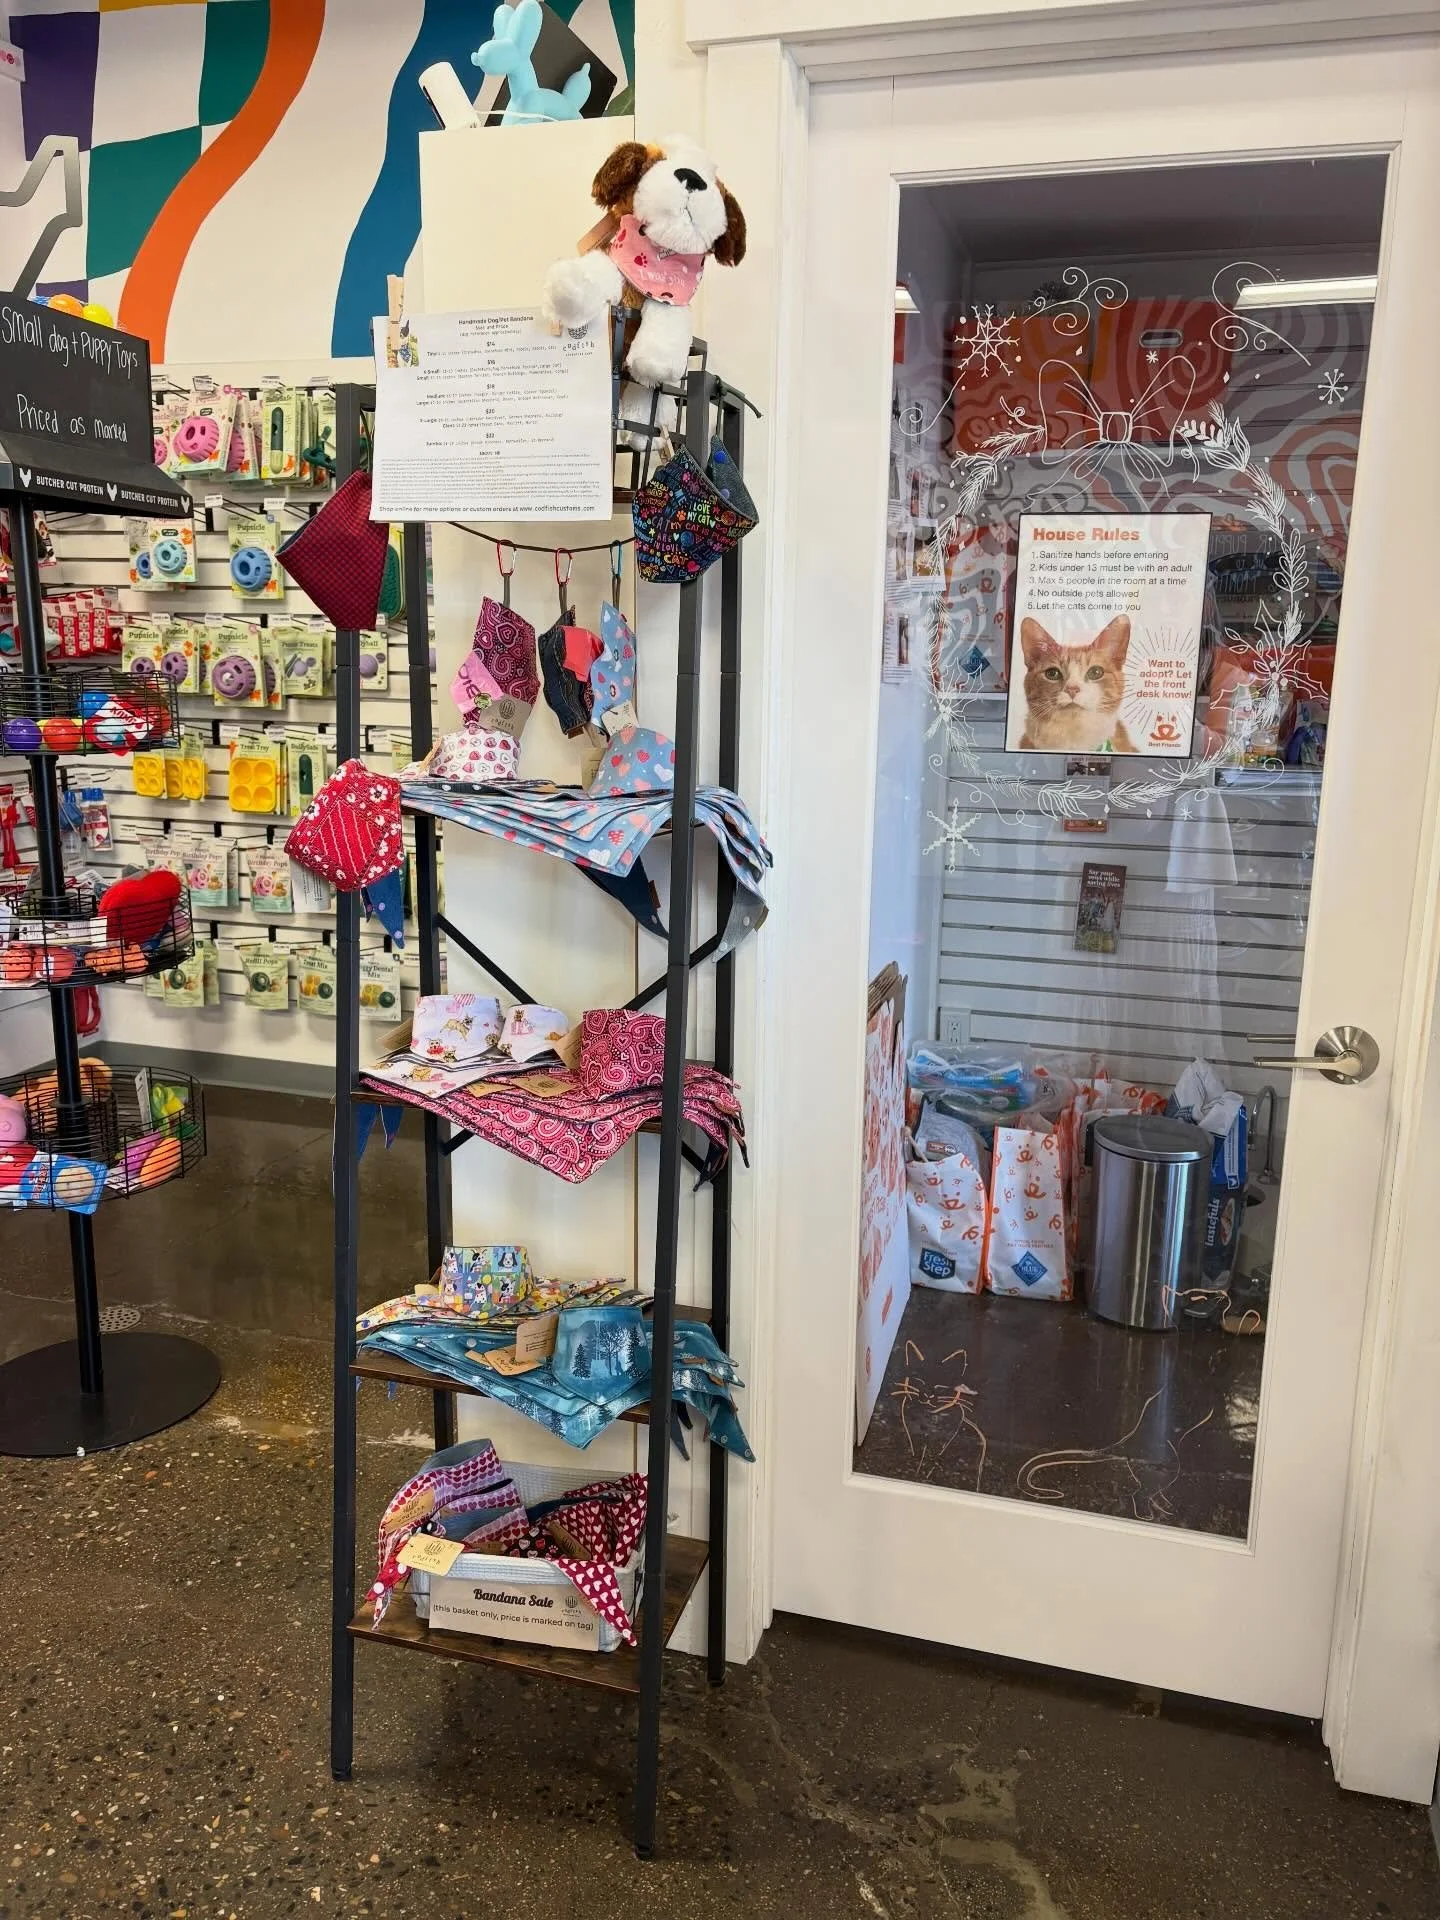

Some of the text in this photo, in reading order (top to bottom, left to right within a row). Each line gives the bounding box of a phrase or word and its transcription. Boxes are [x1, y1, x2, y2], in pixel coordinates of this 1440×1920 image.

[1, 306, 43, 348] Small
[49, 325, 69, 367] dog
[112, 340, 138, 380] Toys
[17, 393, 59, 434] Priced
[70, 416, 86, 436] as
[36, 476, 104, 496] BUTCHER CUT PROTEIN
[121, 490, 179, 508] BUTCHER CUT PROTEIN
[693, 502, 711, 513] LOVE
[687, 512, 697, 520] MY
[237, 524, 265, 532] Pupsicle
[1033, 528, 1140, 541] House Rules
[1039, 551, 1073, 559] Sanitize
[1075, 551, 1101, 559] hands
[1103, 551, 1131, 559] before
[1134, 552, 1169, 560] entering
[1039, 564, 1057, 572] Kids
[1060, 564, 1084, 572] under
[1100, 564, 1121, 572] must
[1123, 564, 1135, 572] be
[1137, 564, 1155, 572] with
[1170, 564, 1192, 572] adult
[1066, 577, 1095, 586] people
[1167, 577, 1186, 585] time
[1051, 589, 1083, 597] outside
[1085, 590, 1103, 599] pets
[1105, 590, 1139, 598] allowed
[1036, 602, 1049, 610] Let
[1052, 602, 1065, 610] the
[1114, 603, 1123, 611] to
[1125, 604, 1141, 612] you
[128, 632, 160, 640] Pupsicle
[1148, 659, 1185, 668] Want to
[1139, 670, 1192, 681] adopt? Let
[1144, 680, 1186, 689] the front
[1136, 690, 1192, 699] desk know!
[924, 1251, 952, 1266] Fresh
[924, 1263, 950, 1278] Step
[473, 1588, 554, 1608] Bandana Sale
[433, 1604, 450, 1613] (this
[452, 1606, 478, 1617] basket
[480, 1610, 499, 1621] only,
[500, 1614, 520, 1623] price
[531, 1617, 562, 1627] marked
[564, 1620, 576, 1628] on
[577, 1621, 594, 1632] tag)
